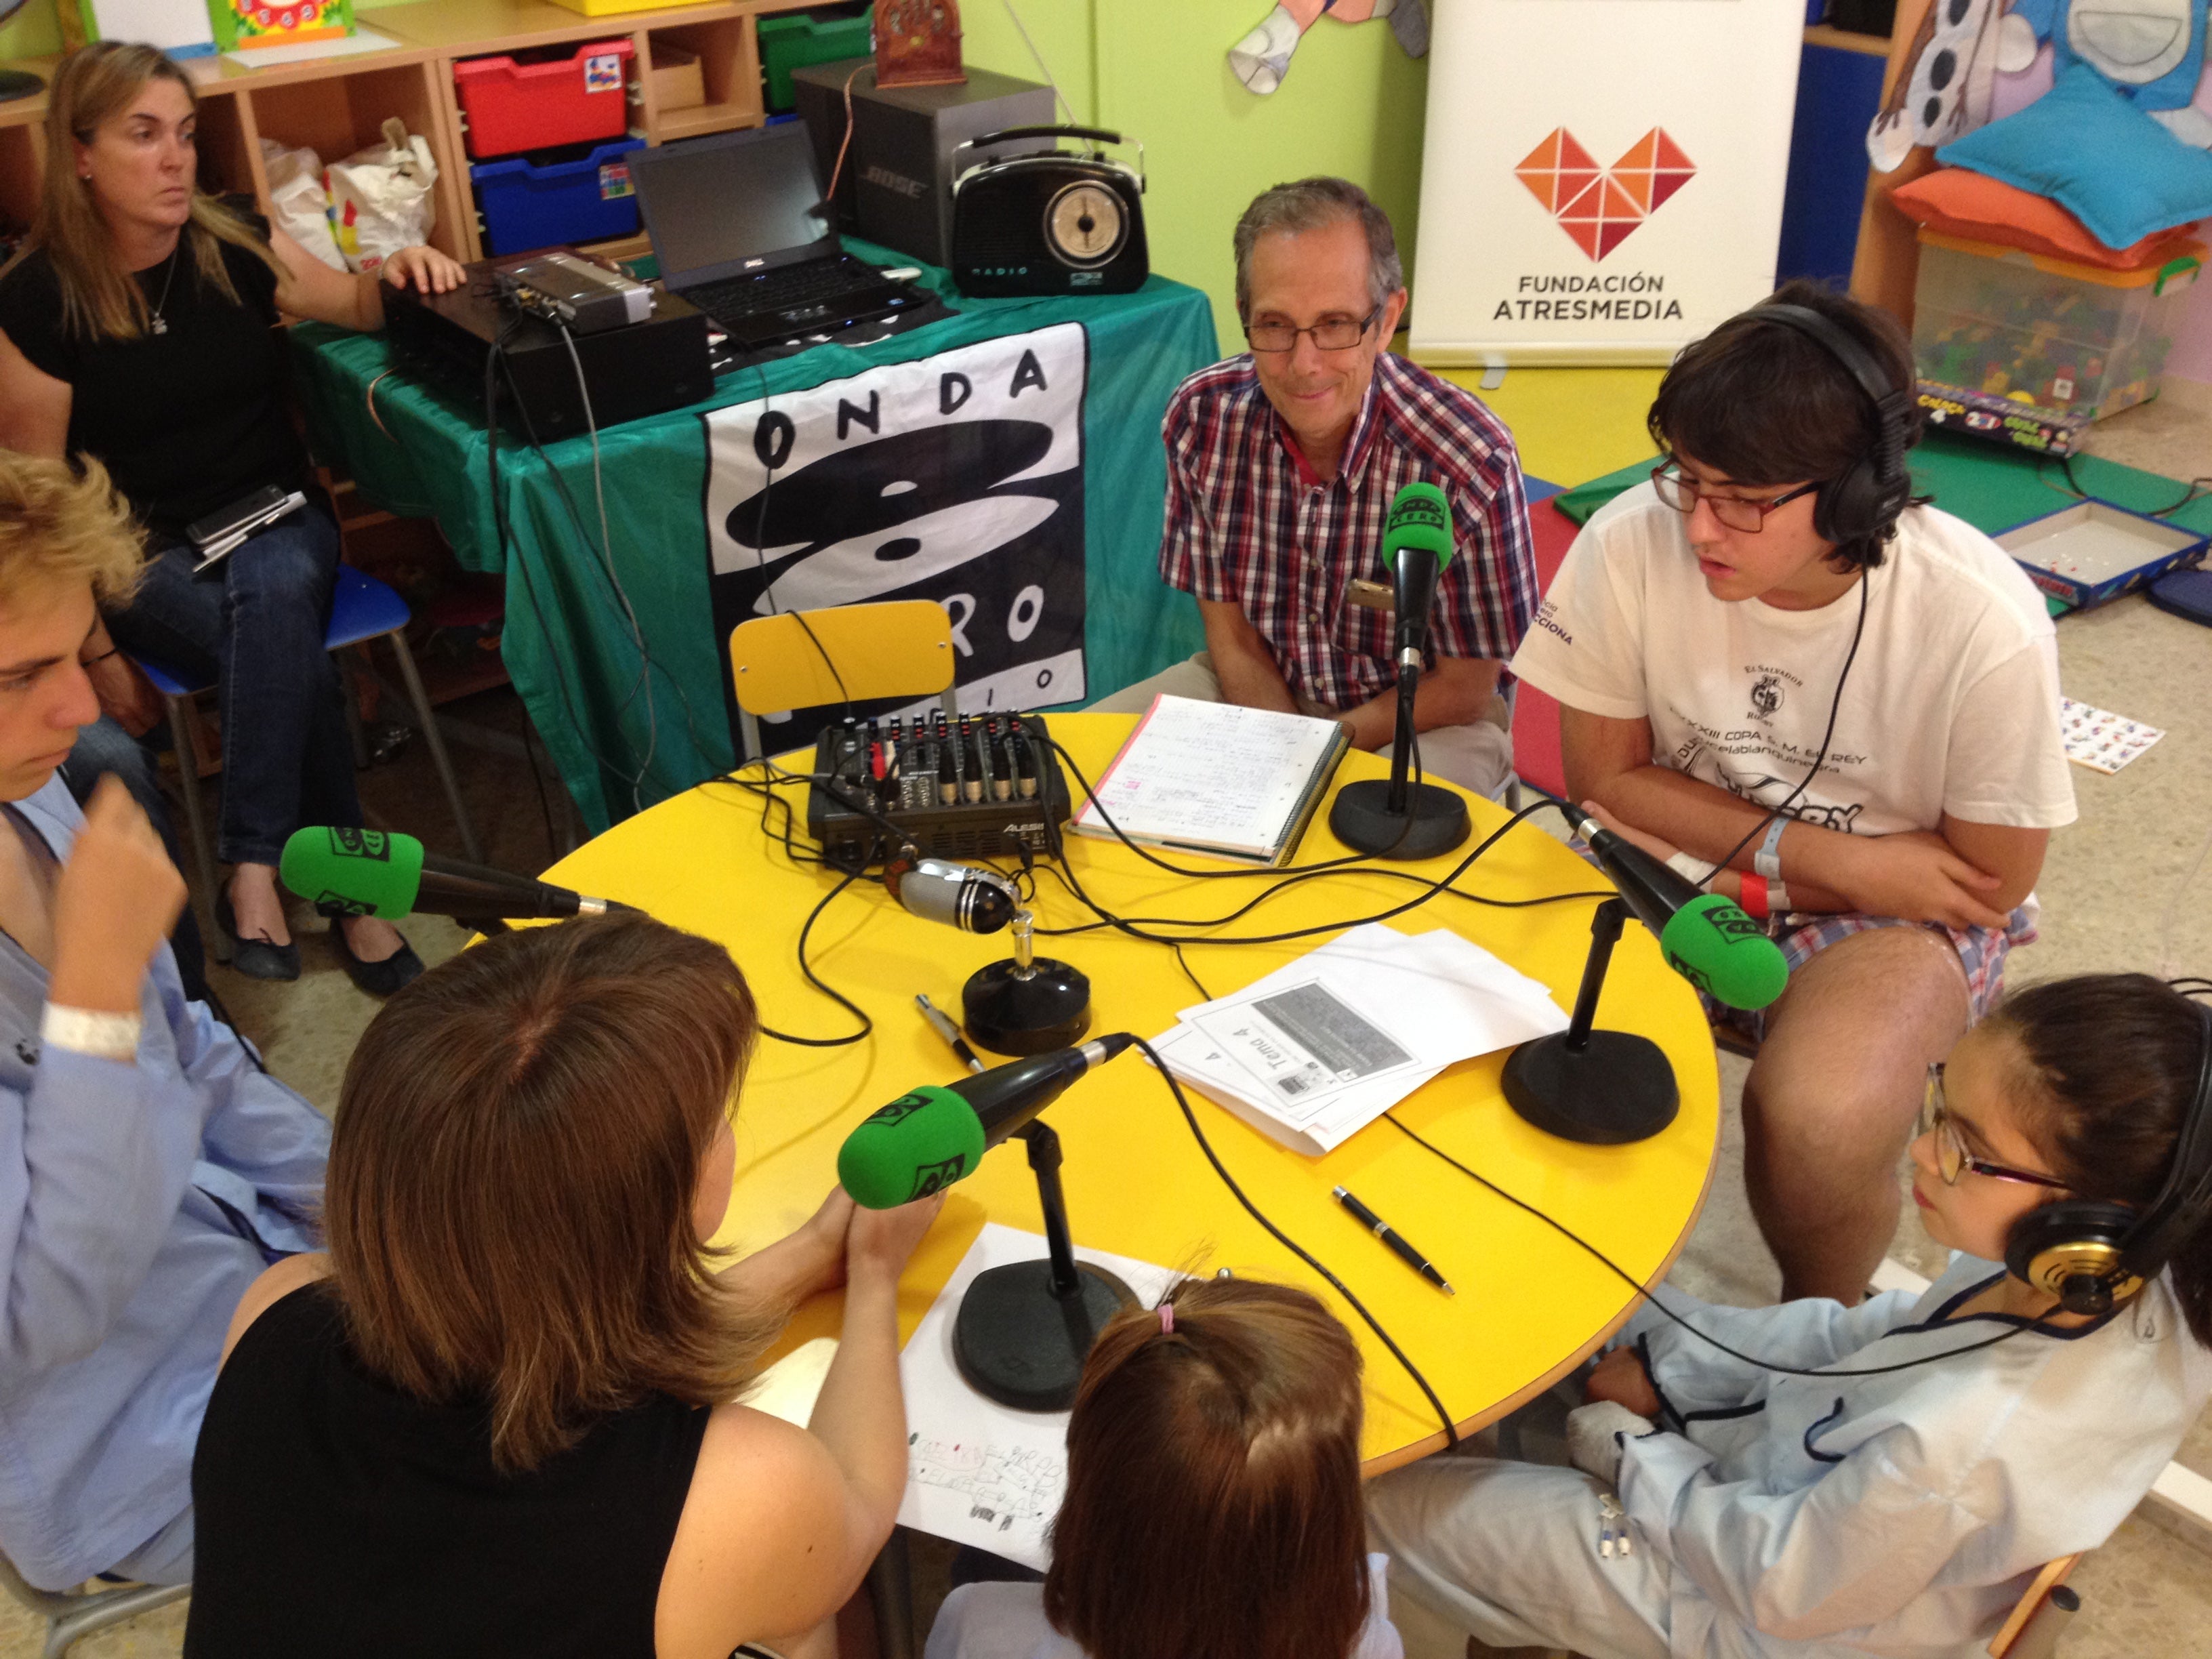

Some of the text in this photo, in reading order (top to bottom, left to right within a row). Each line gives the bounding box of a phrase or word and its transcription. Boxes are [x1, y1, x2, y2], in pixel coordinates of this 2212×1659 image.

[866, 165, 929, 199] BOSE
[971, 266, 1028, 276] RADIO
[1519, 271, 1664, 293] FUNDACIÓN
[1493, 299, 1683, 321] ATRESMEDIA
[754, 348, 1048, 470] ONDA
[1534, 613, 1573, 645] CCIONA
[1725, 731, 1762, 741] COPA
[1831, 753, 1868, 764] REY
[1249, 1038, 1287, 1070] Tema
